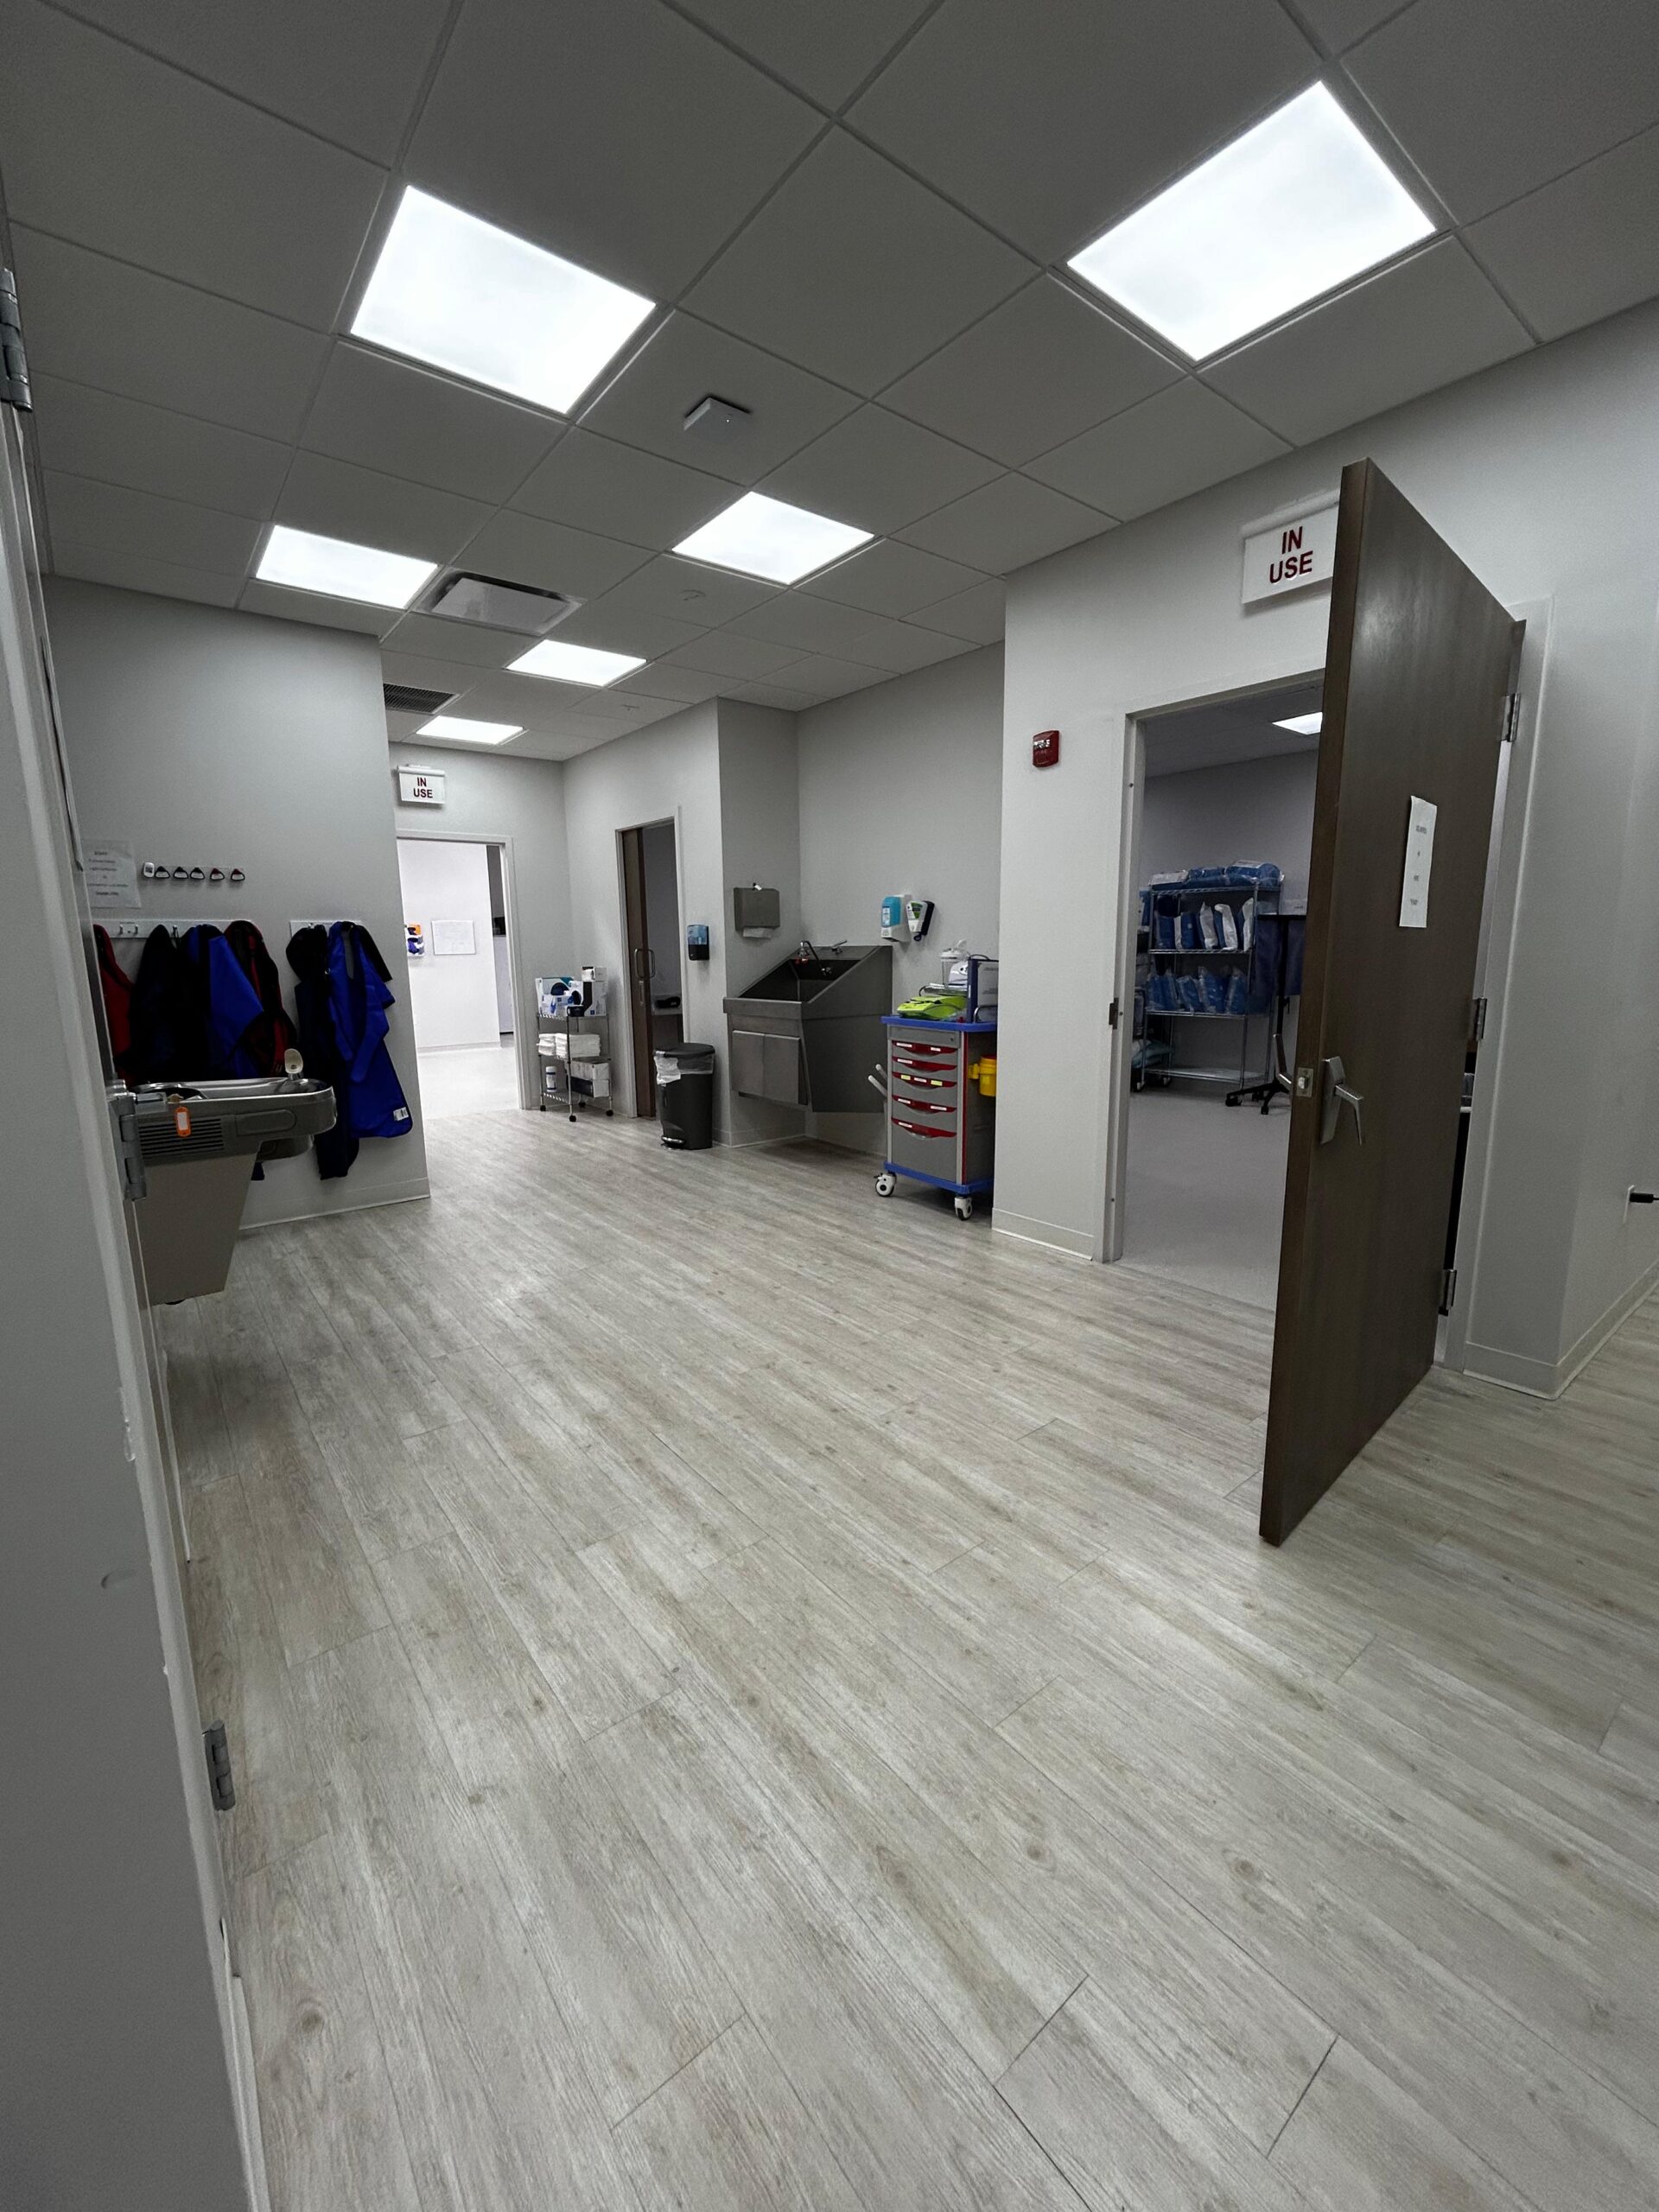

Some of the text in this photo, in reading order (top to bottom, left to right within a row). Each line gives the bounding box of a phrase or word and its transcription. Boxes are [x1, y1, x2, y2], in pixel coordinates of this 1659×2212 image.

[1281, 526, 1303, 554] IN
[1269, 550, 1313, 583] USE
[417, 777, 427, 787] IN
[413, 788, 433, 798] USE
